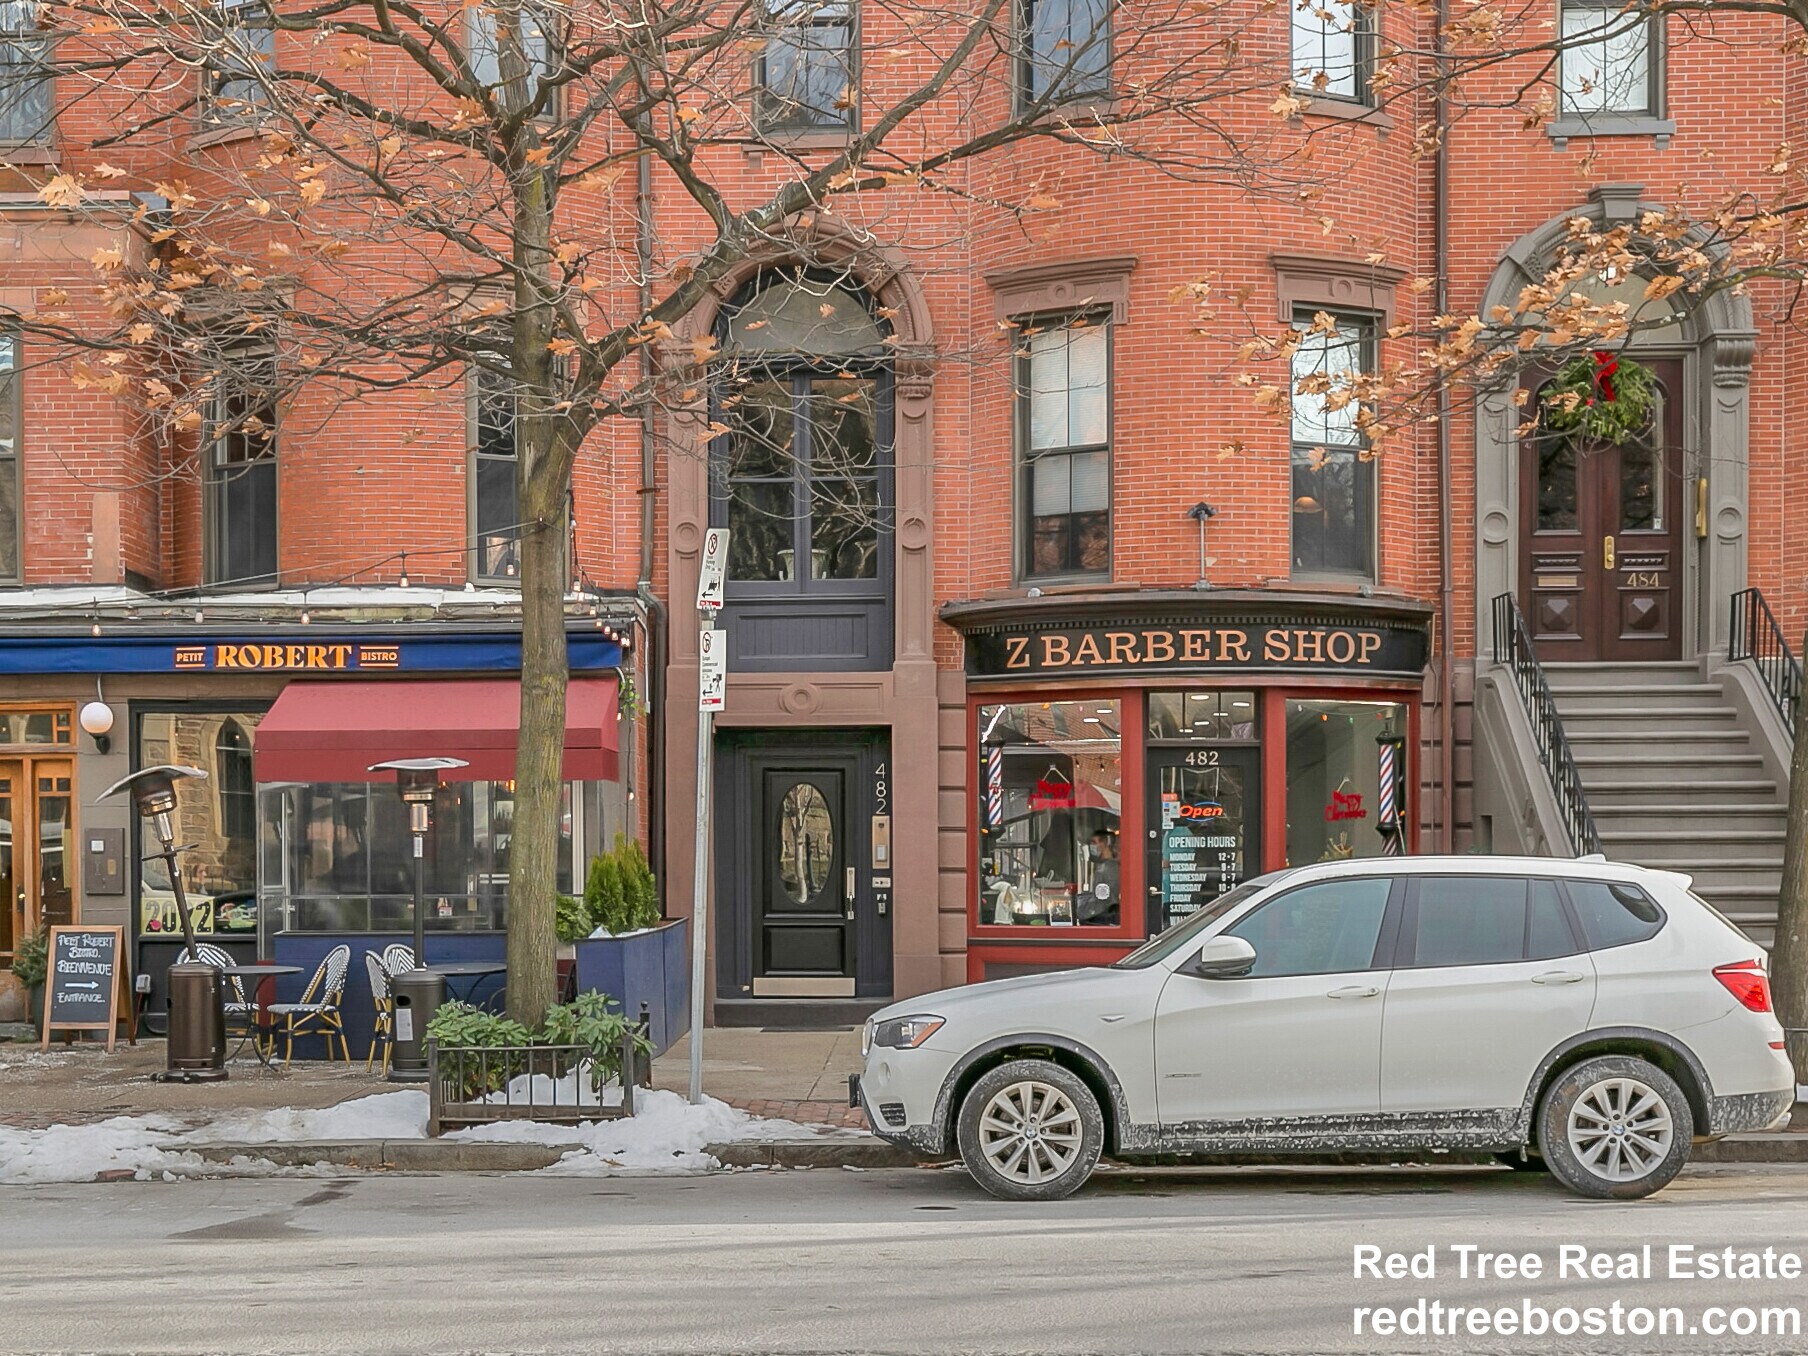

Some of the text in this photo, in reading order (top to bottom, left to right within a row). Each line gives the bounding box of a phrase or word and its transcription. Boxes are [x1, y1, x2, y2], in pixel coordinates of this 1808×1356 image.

[1627, 572, 1659, 587] 484
[1005, 629, 1382, 669] Z BARBER SHOP
[176, 644, 398, 669] PETIT ROBERT BISTRO
[1185, 751, 1219, 765] 482
[1178, 804, 1223, 818] Open
[1169, 836, 1236, 848] OPENING HOURS
[1169, 852, 1196, 862] MONDAY
[1169, 863, 1198, 872] TUESDAY
[1169, 873, 1207, 882] WEDNESDAY
[1169, 883, 1202, 893] THURSDAY
[1169, 894, 1192, 903] FRIDAY
[82, 933, 115, 948] ROBERT
[57, 959, 112, 976] BIENVENUE
